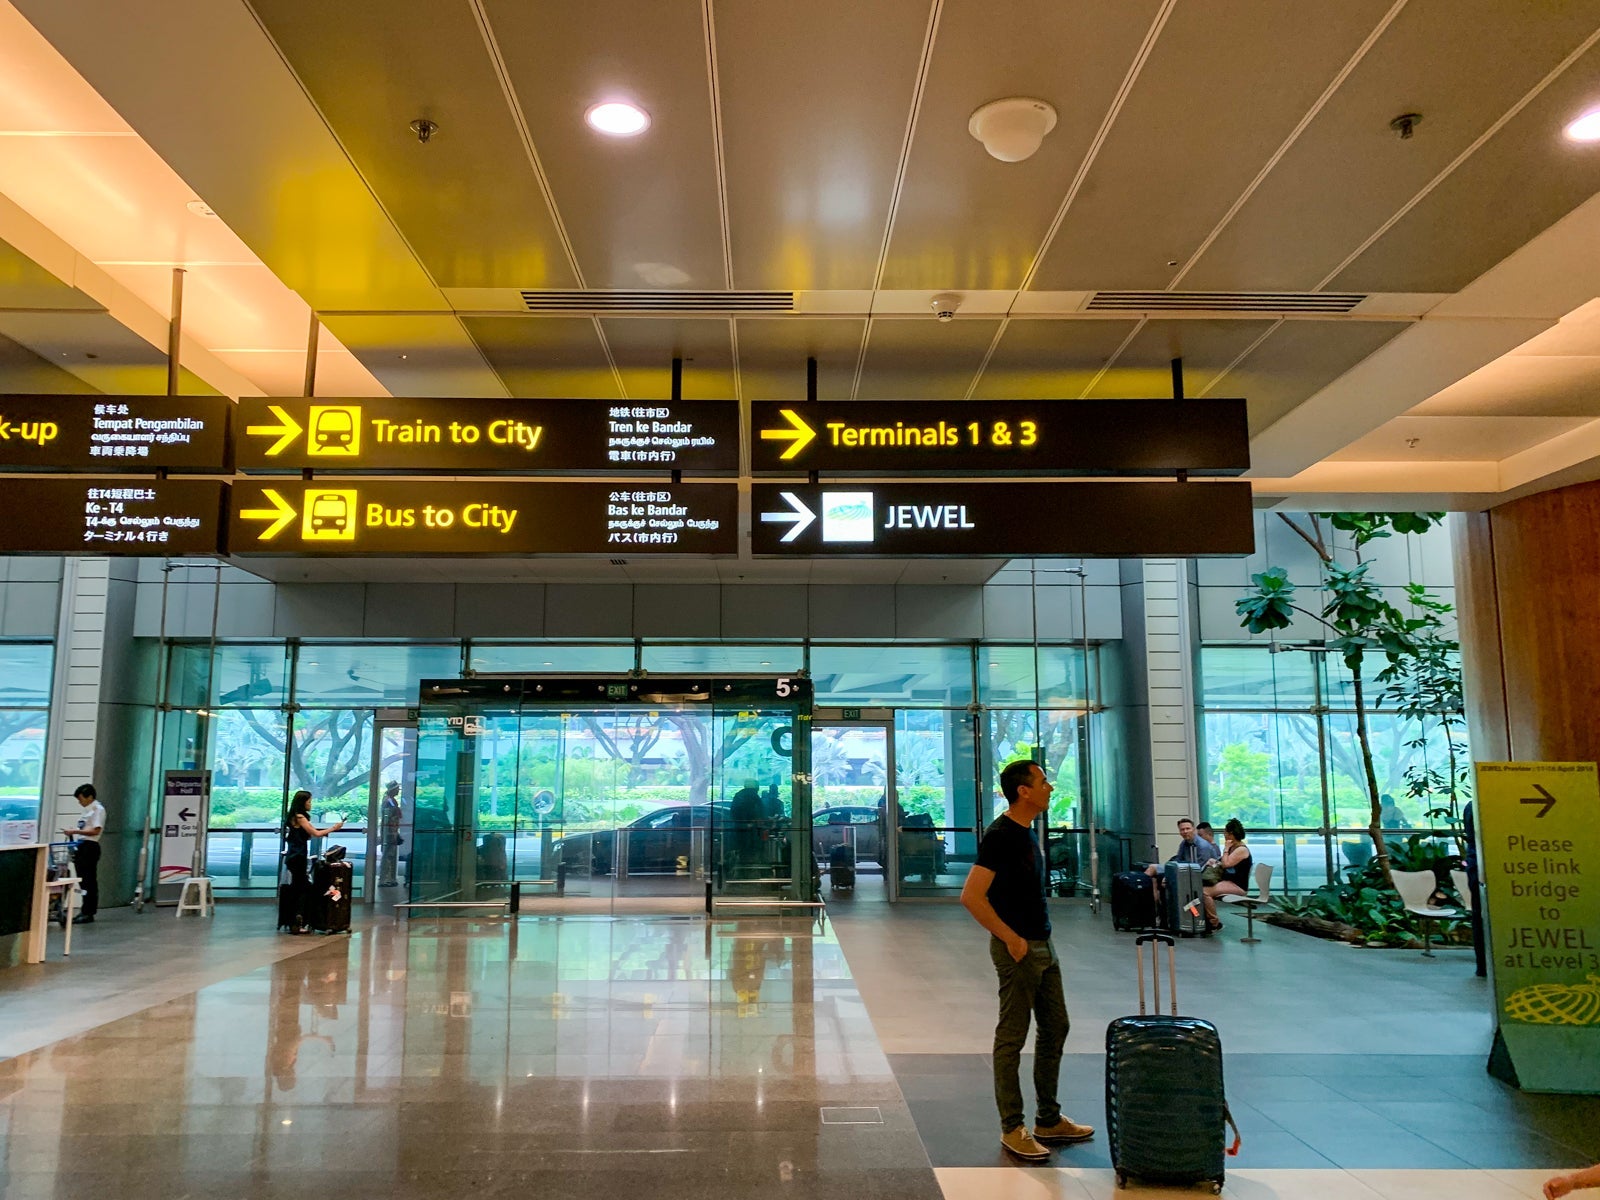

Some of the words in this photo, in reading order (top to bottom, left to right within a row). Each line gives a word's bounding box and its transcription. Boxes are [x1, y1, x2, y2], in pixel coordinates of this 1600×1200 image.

[92, 417, 133, 431] Tempat
[135, 418, 204, 431] Pengambilan
[608, 421, 633, 433] Tren
[636, 421, 649, 433] ke
[652, 421, 693, 433] Bandar
[371, 419, 440, 443] Train
[445, 421, 480, 443] to
[488, 420, 542, 450] City
[826, 420, 959, 447] Terminals
[968, 422, 979, 446] 1
[991, 421, 1013, 446] &
[1020, 421, 1037, 446] 3
[85, 501, 101, 514] Ke
[109, 501, 124, 514] T4
[608, 504, 629, 516] Bas
[631, 504, 644, 516] ke
[647, 504, 688, 516] Bandar
[366, 503, 415, 527] Bus
[423, 504, 454, 527] to
[463, 503, 518, 534] City
[884, 505, 975, 529] JEWEL
[608, 685, 626, 695] EXIT
[776, 678, 791, 698] 5
[1507, 835, 1574, 852] Please
[1503, 861, 1538, 875] use
[1543, 857, 1581, 875] link
[1511, 880, 1580, 902] bridge
[1539, 905, 1561, 921] to
[1508, 927, 1594, 950] JEWEL
[1504, 954, 1524, 969] at
[1529, 951, 1583, 970] Level
[1588, 954, 1600, 970] 3
